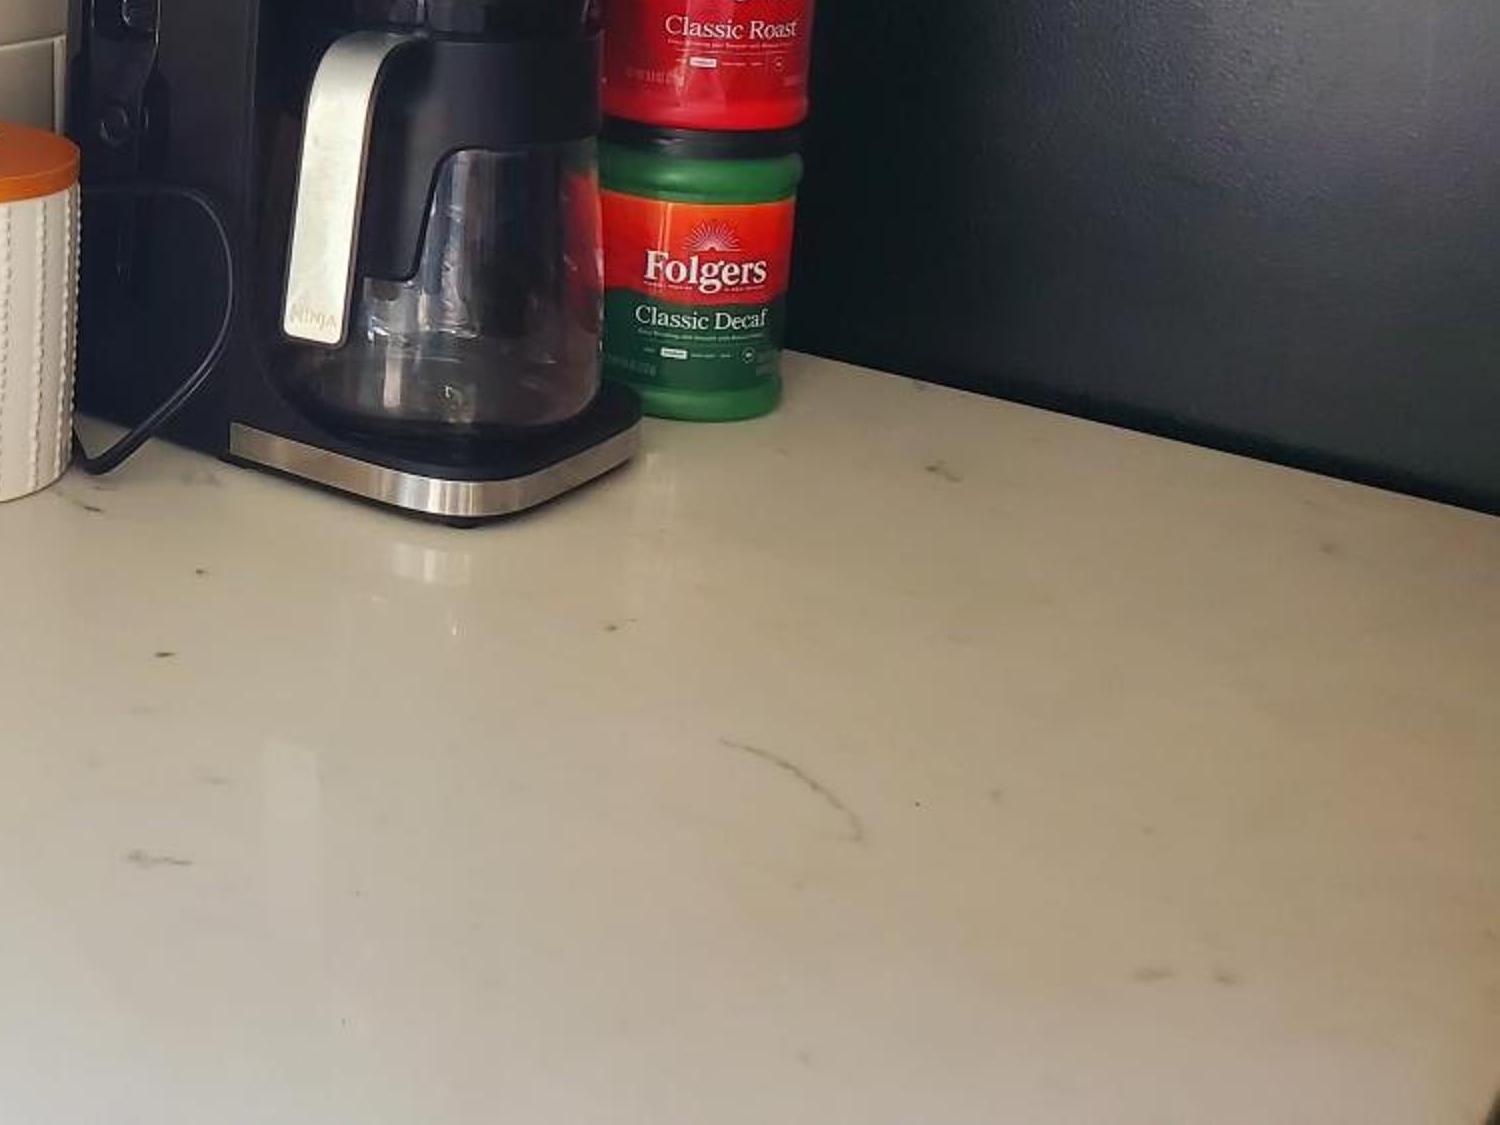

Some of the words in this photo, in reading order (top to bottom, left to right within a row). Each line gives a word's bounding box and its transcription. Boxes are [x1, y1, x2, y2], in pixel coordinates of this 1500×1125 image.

[665, 14, 744, 40] Classic
[749, 20, 797, 40] Roast
[644, 249, 767, 294] Folgers
[635, 305, 710, 331] Classic
[714, 308, 768, 331] Decaf
